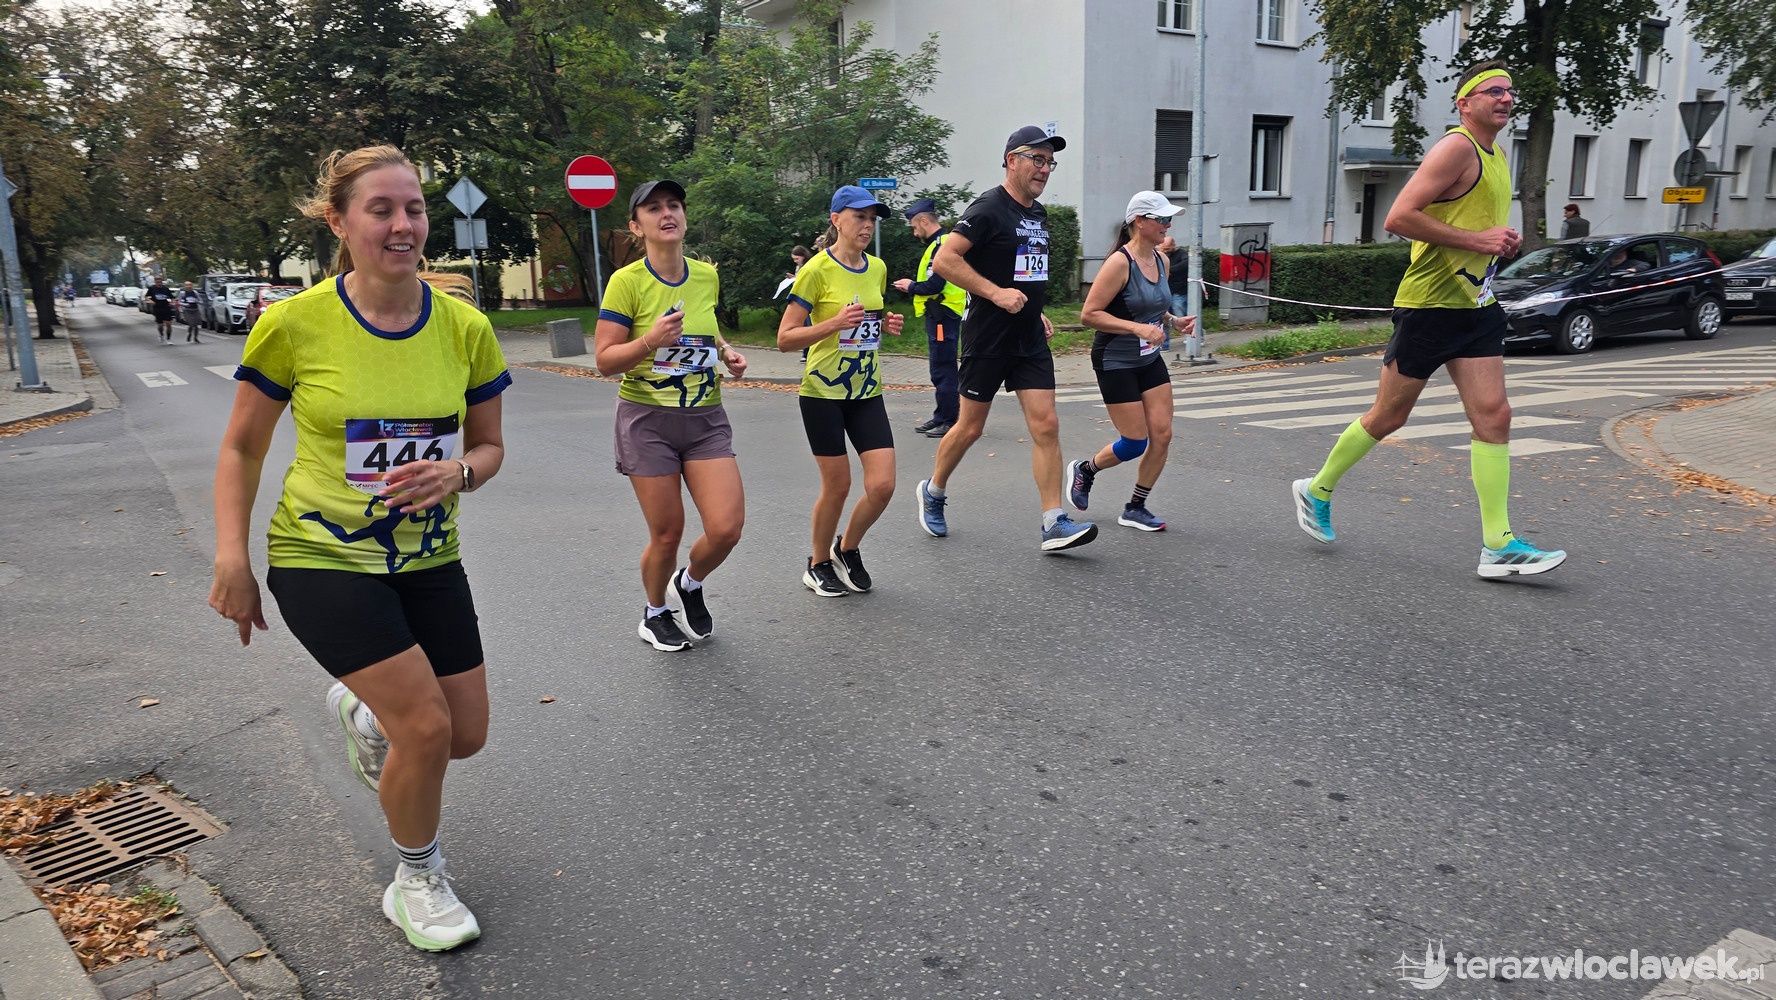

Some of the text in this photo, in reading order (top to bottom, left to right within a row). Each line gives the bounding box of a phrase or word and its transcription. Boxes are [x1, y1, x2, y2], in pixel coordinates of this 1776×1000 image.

[1667, 189, 1702, 197] Objazd
[1024, 255, 1044, 271] 126
[665, 347, 710, 366] 727
[363, 438, 444, 473] 446
